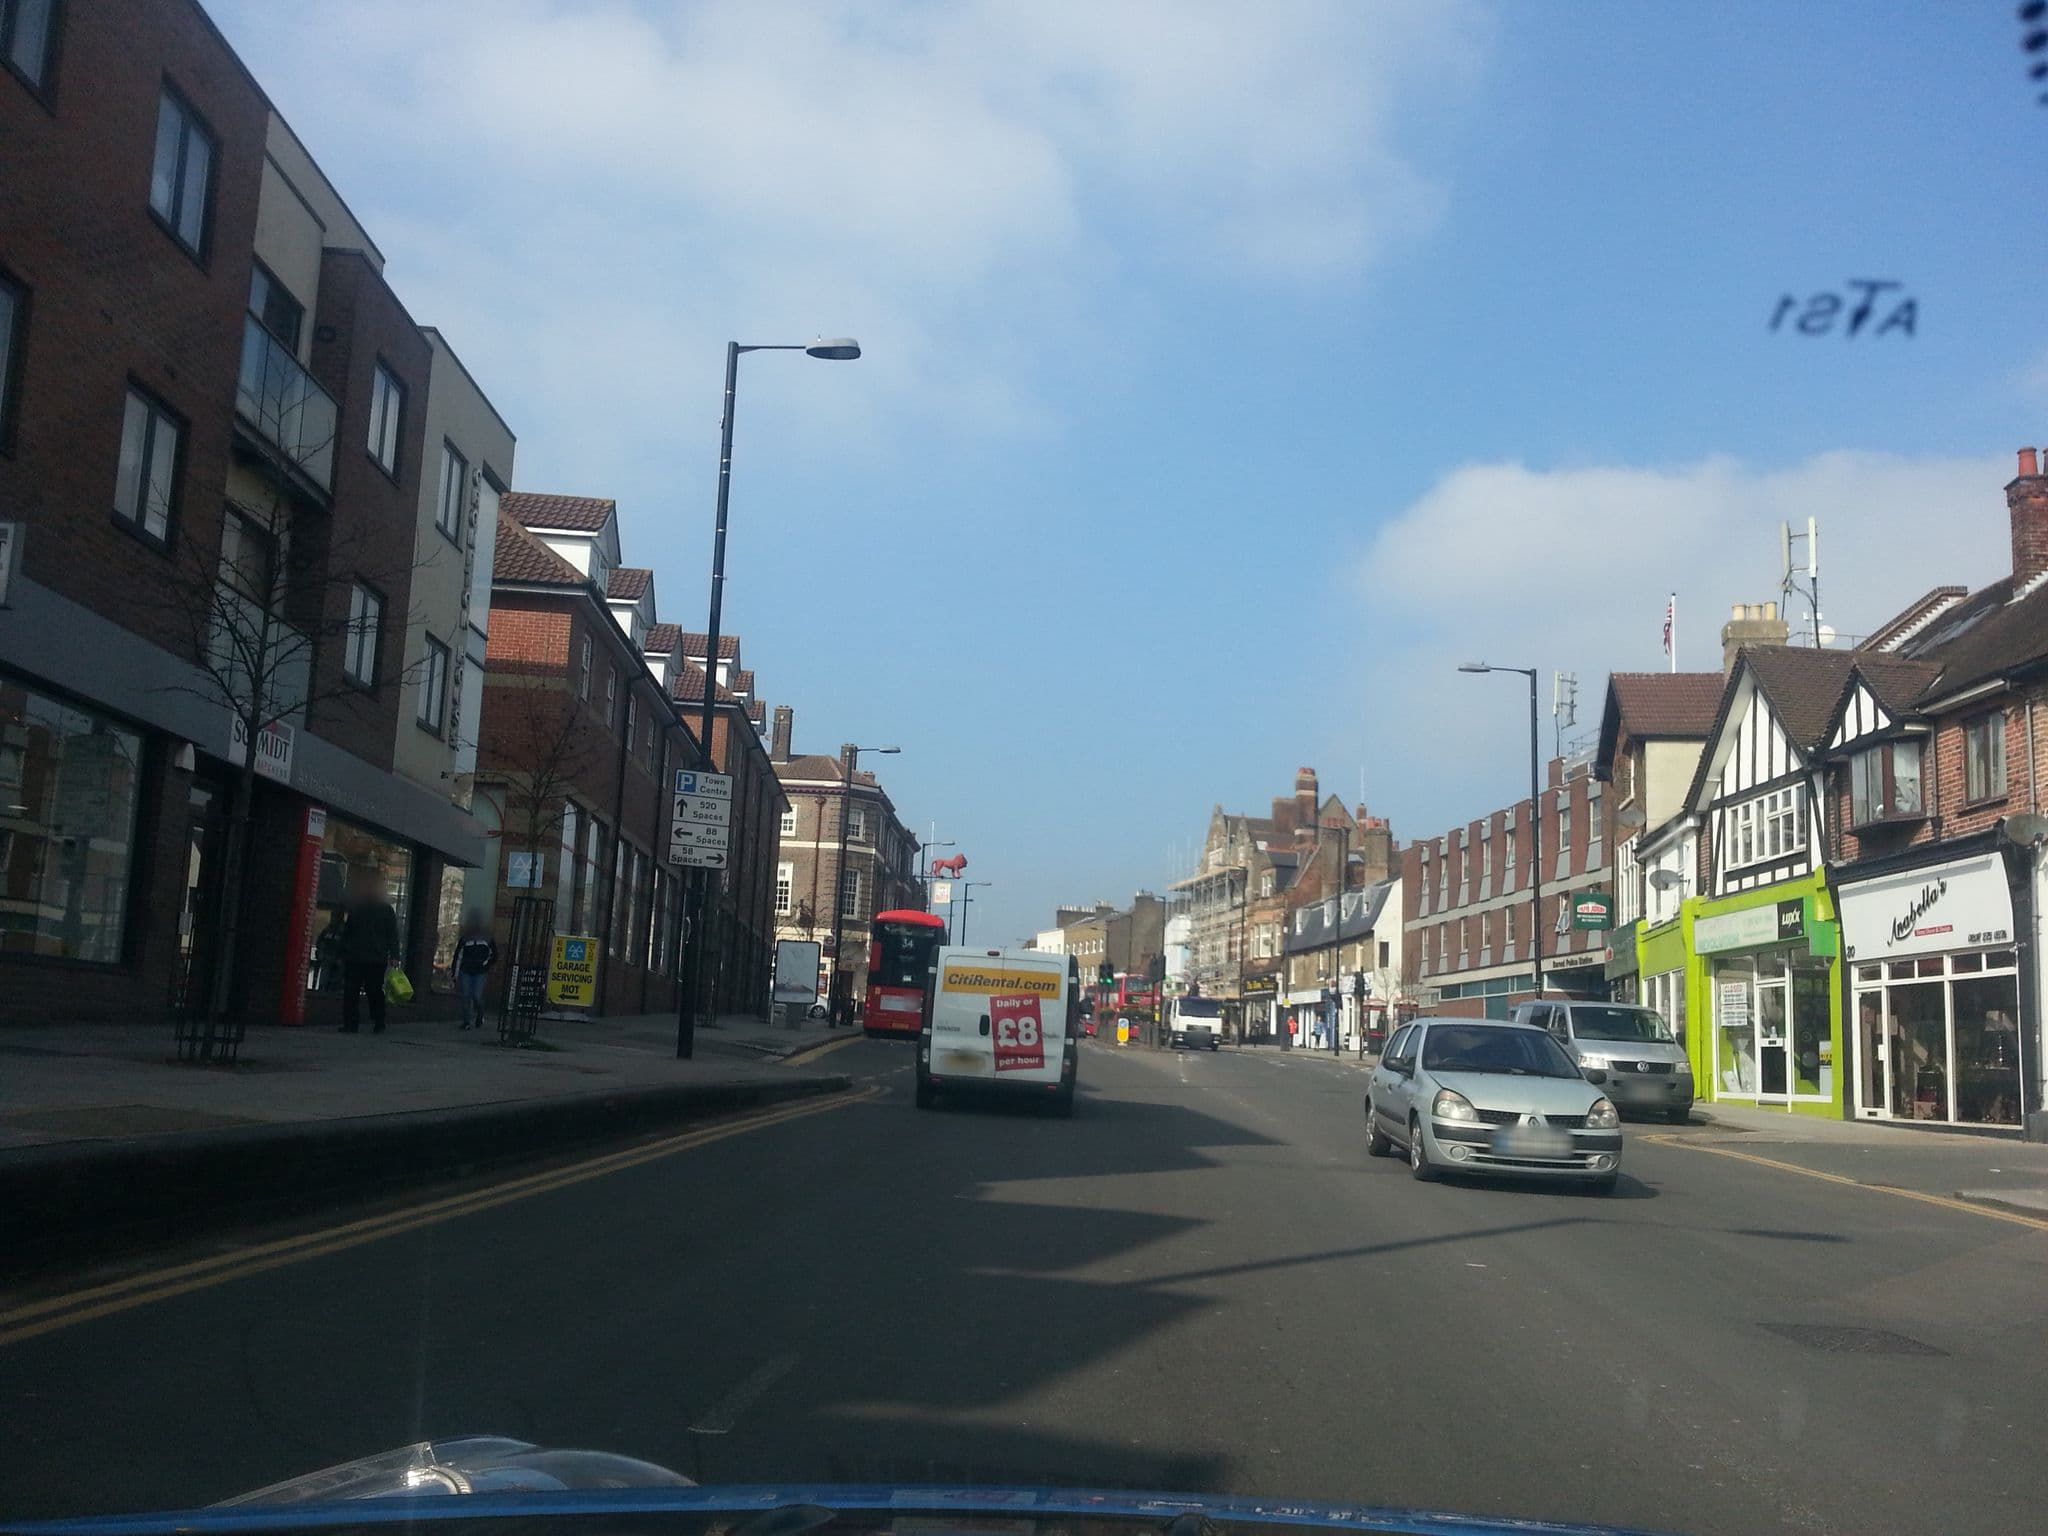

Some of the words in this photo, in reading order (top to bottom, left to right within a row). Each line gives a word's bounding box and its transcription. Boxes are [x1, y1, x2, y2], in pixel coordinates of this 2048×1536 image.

[705, 776, 725, 786] Town
[700, 785, 728, 796] Centre
[700, 801, 717, 810] 520
[693, 811, 723, 822] Spaces
[706, 827, 717, 836] 88
[696, 836, 726, 846] Spaces
[682, 847, 694, 856] 58
[671, 854, 702, 865] Spaces
[556, 961, 591, 973] GARAGE
[551, 972, 593, 984] SERVICING
[948, 972, 1057, 992] CitiRental.com
[561, 984, 580, 994] MOT
[996, 998, 1021, 1008] Daily
[1023, 998, 1034, 1006] or
[997, 1016, 1039, 1048] £8
[998, 1058, 1015, 1067] per
[1017, 1056, 1039, 1065] hour
